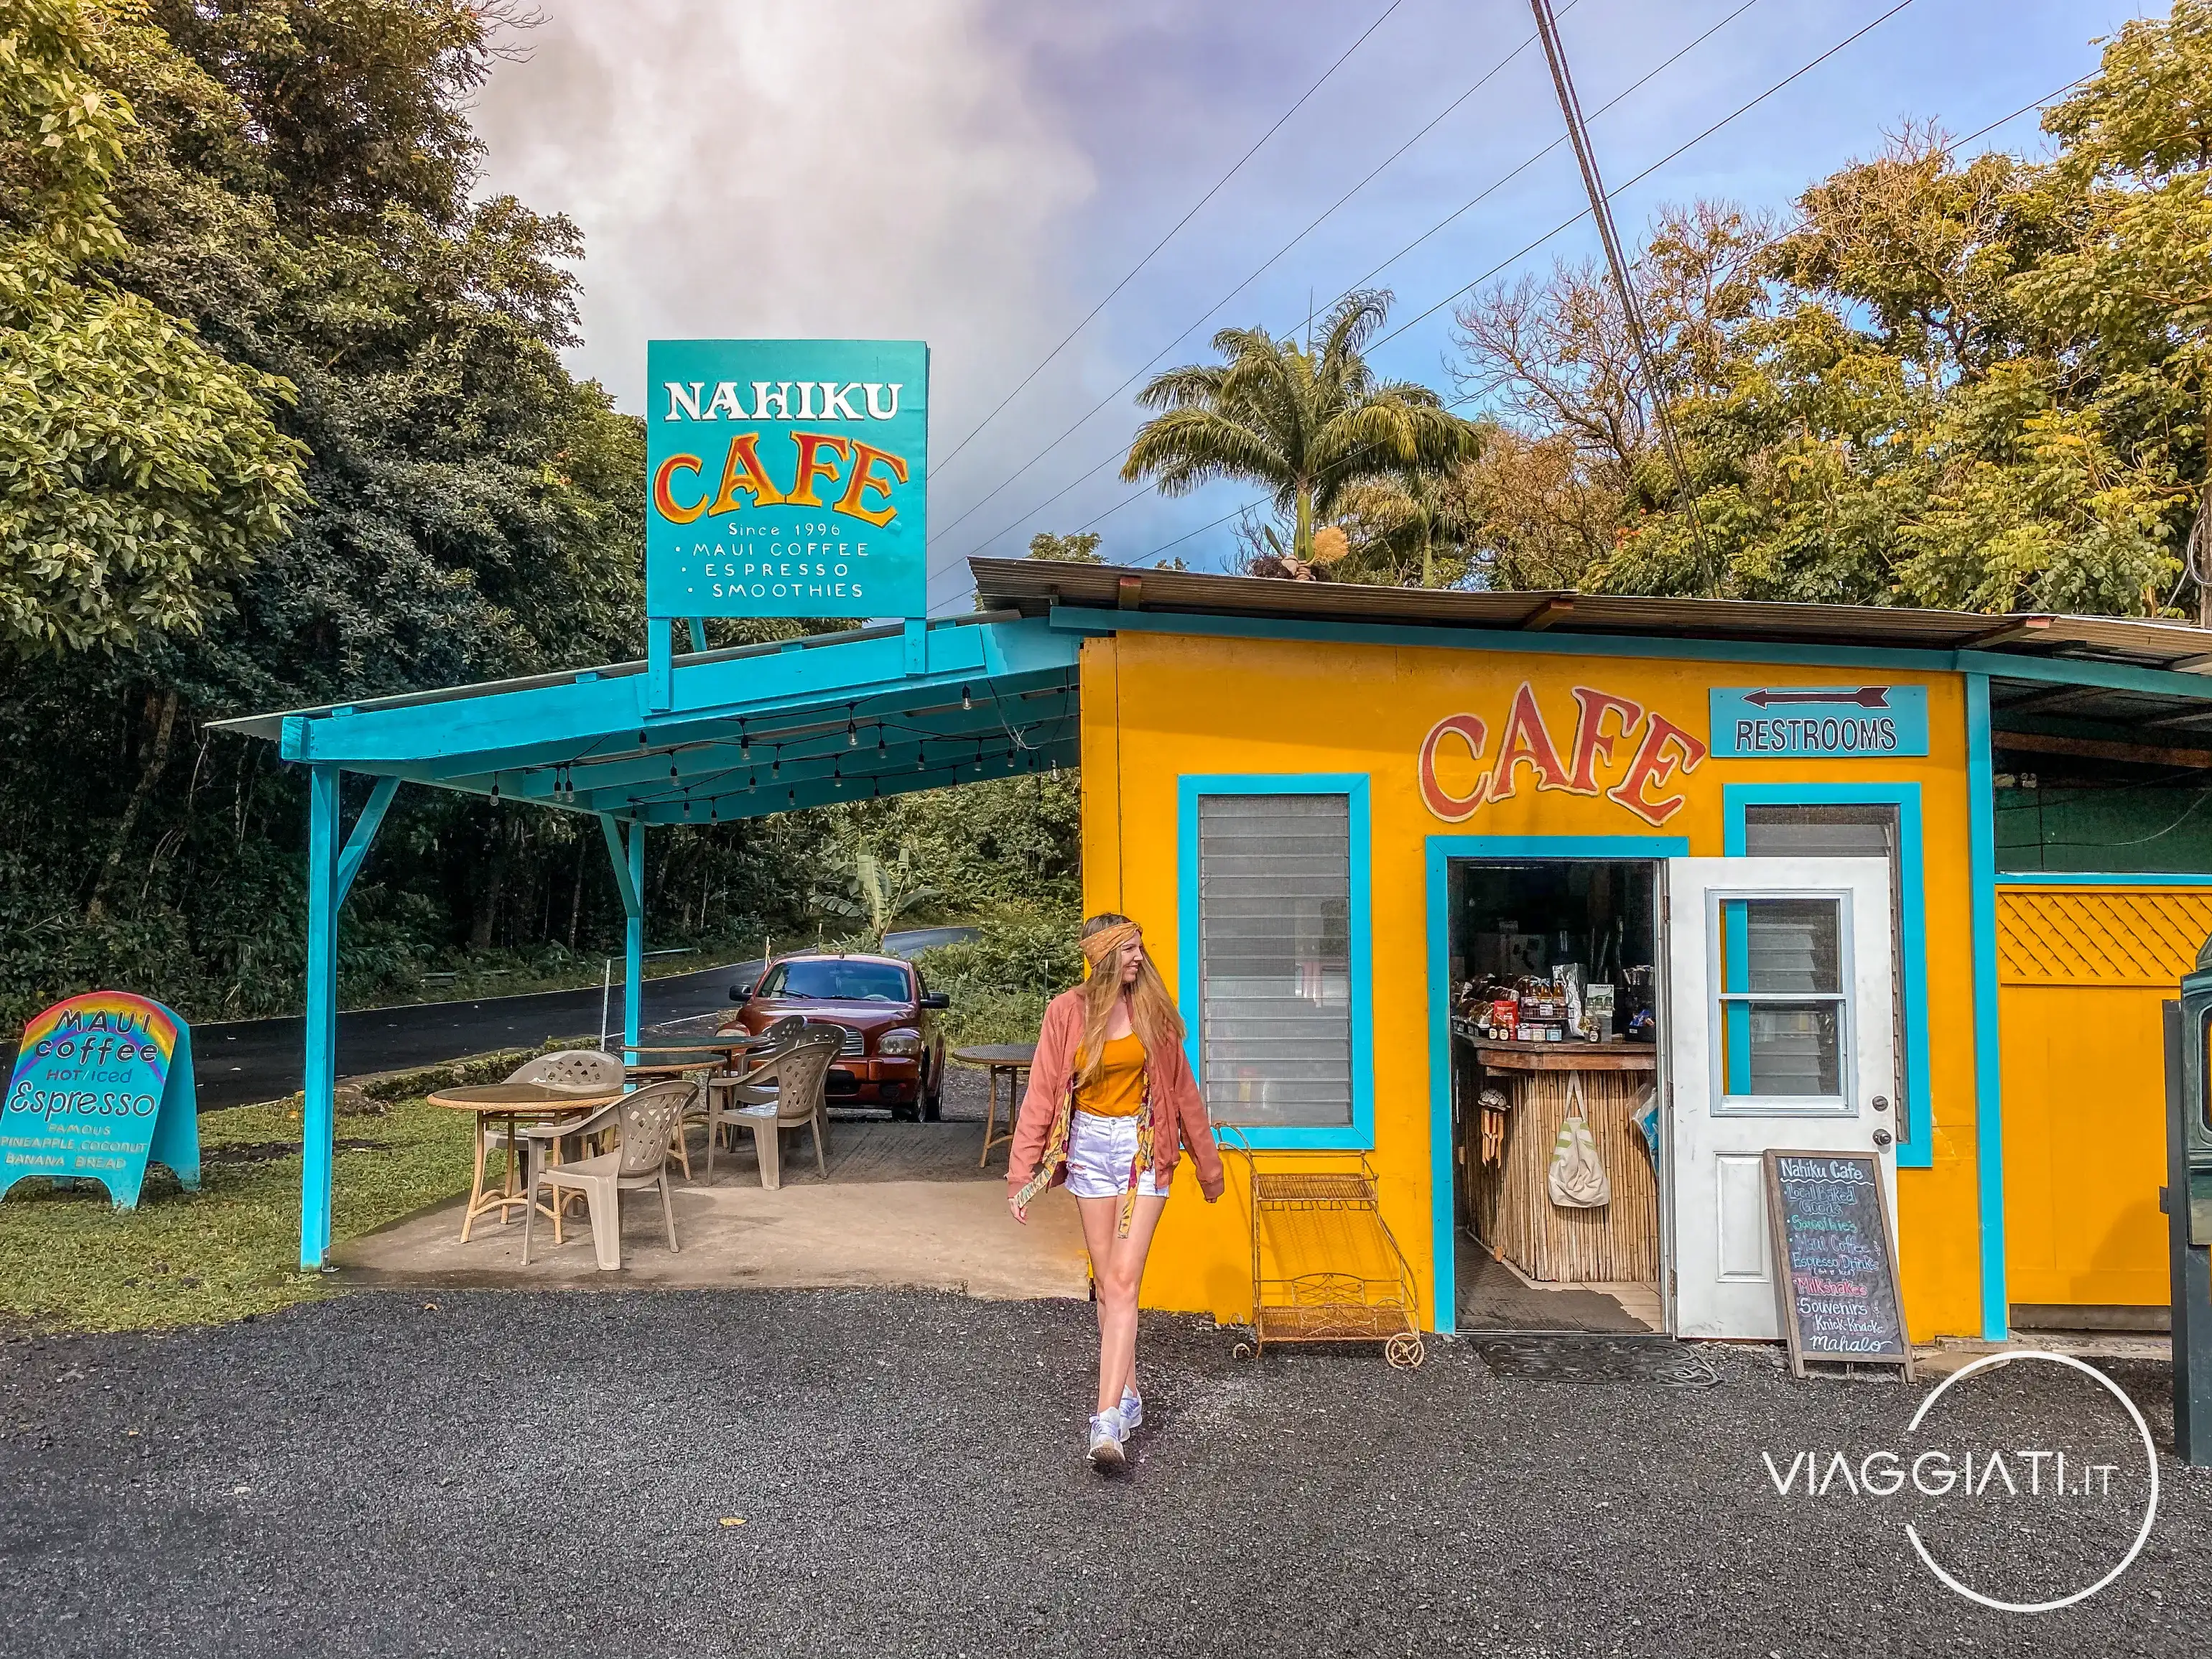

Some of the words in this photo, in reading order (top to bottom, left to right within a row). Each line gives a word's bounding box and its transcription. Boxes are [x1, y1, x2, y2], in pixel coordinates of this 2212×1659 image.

[663, 381, 903, 422] NAHIKU
[653, 431, 908, 529] CAFE
[728, 522, 780, 536] Since
[795, 523, 840, 536] 1996
[693, 543, 753, 557] MAUI
[770, 543, 870, 557] COFFEE
[705, 564, 849, 577] ESPRESSO
[712, 584, 863, 598] SMOOTHIES
[1734, 717, 1898, 752] RESTROOMS
[1418, 681, 1706, 827] CAFE
[53, 1009, 152, 1034] MAUI
[34, 1036, 159, 1066] coffee
[9, 1080, 156, 1123] Espresso
[47, 1123, 111, 1135] FAMOUS
[5, 1152, 65, 1166] BANANA
[75, 1156, 126, 1169] BREAD
[1780, 1158, 1827, 1178] Nahiku
[1830, 1160, 1864, 1179] Cafe
[1786, 1184, 1816, 1202] Local
[1817, 1185, 1857, 1204] Baked
[1800, 1199, 1843, 1216] Goods
[1792, 1214, 1858, 1233] Smoothies
[1795, 1232, 1828, 1253] Maui
[1829, 1234, 1870, 1255] Coffee
[1792, 1252, 1839, 1270] Espresso
[1839, 1254, 1879, 1271] Drinks
[1798, 1278, 1868, 1298] Milkshakes
[1800, 1298, 1867, 1316] Souvenirs
[1814, 1314, 1883, 1334] Knick-Knacks
